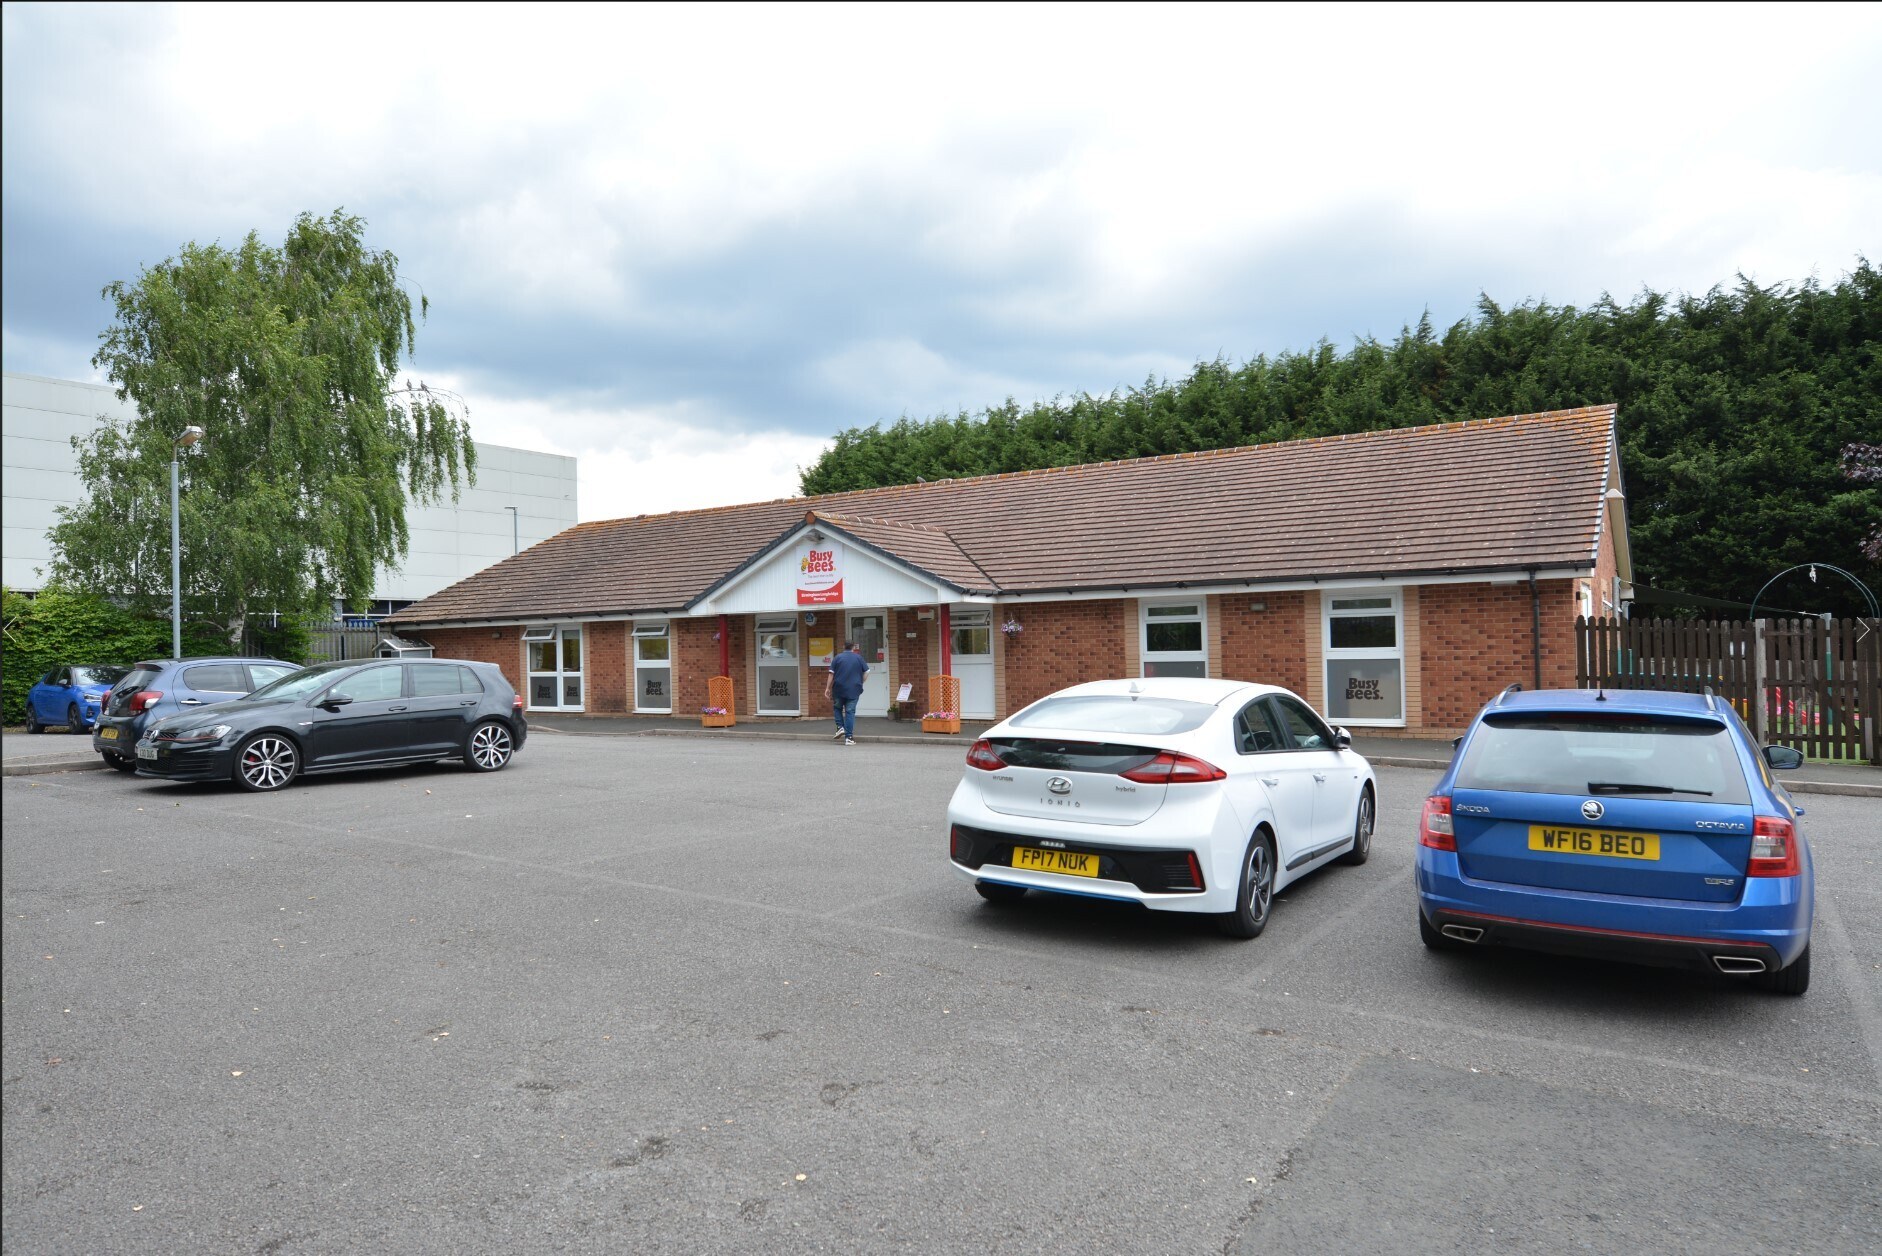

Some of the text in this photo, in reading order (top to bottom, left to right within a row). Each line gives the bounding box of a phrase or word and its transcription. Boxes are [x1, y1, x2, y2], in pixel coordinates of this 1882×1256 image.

[809, 550, 833, 563] Busy
[647, 679, 662, 689] Busy
[770, 679, 788, 690] Busy
[1348, 677, 1379, 690] Busy
[1345, 688, 1384, 700] Bees.
[1695, 820, 1746, 831] OCTAVIA
[1542, 830, 1646, 857] WF16 BEO
[1021, 849, 1088, 871] FP17 NUK
